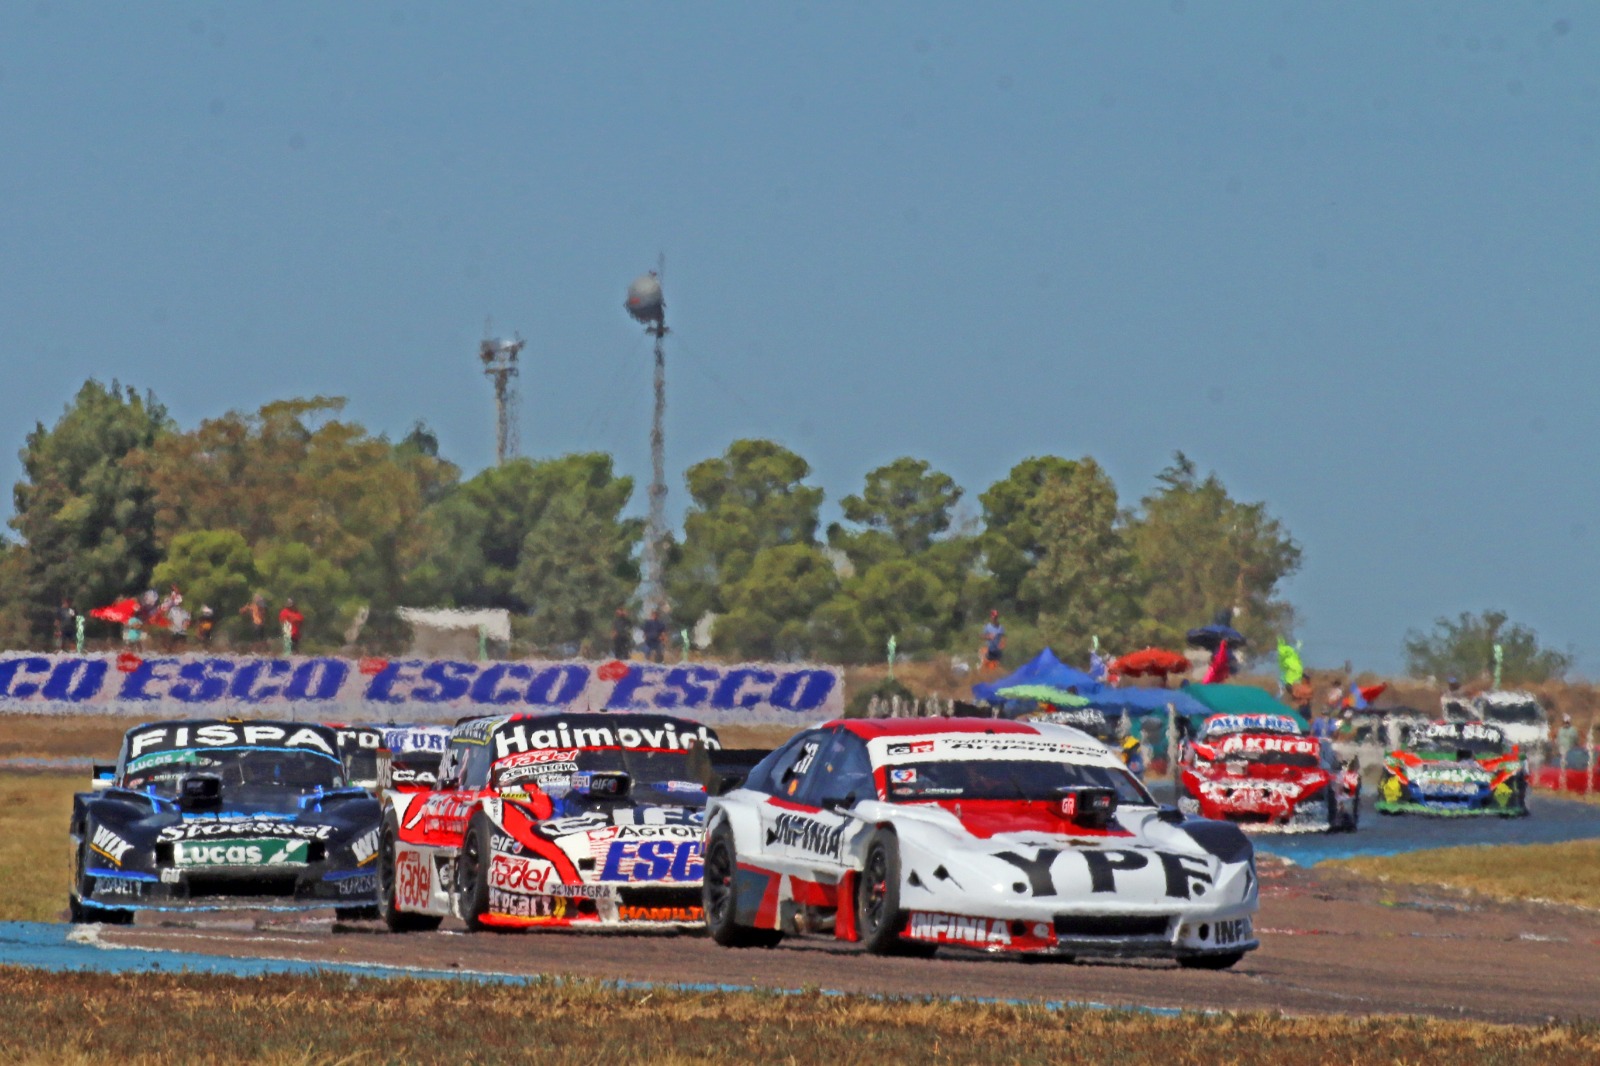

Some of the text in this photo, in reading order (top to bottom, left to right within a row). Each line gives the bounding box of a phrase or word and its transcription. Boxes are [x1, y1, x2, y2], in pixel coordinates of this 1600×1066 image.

[117, 656, 348, 704] ESCO
[364, 657, 591, 707] ESCO
[605, 662, 836, 711] ESCO
[131, 725, 335, 758] FISPA
[495, 722, 721, 759] Haimovich
[887, 741, 934, 755] GR
[129, 755, 173, 773] Lucas
[526, 763, 578, 775] INTEGRA
[1062, 797, 1075, 815] GR
[92, 824, 136, 863] WIX
[490, 833, 515, 851] elf
[772, 813, 845, 859] INFINIA
[173, 842, 263, 864] Lucas
[565, 885, 611, 897] INTEGRA
[990, 849, 1213, 901] YPF
[619, 905, 705, 920] HAMILT
[911, 911, 1011, 945] INFINIA
